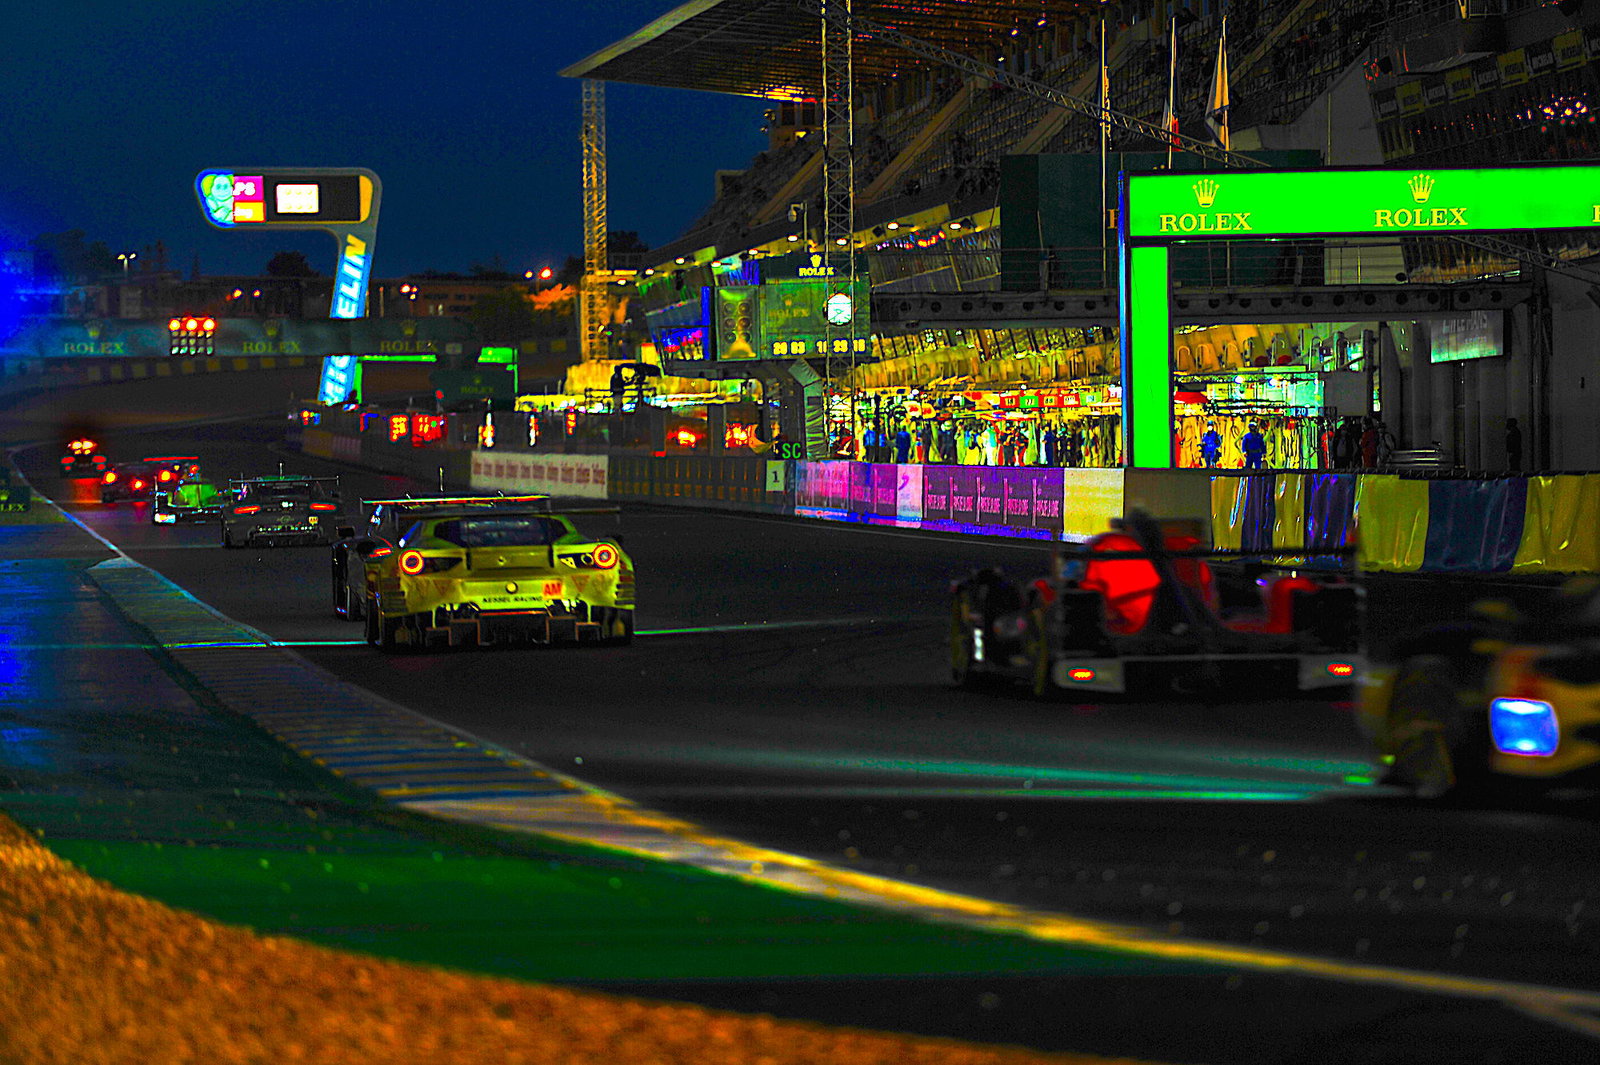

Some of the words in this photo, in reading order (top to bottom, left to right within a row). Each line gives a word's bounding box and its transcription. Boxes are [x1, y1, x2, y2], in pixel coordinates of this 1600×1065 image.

[1159, 212, 1252, 233] ROLEX
[1373, 207, 1468, 228] ROLEX
[798, 266, 835, 277] ROLEX
[324, 234, 366, 406] MICELIN
[63, 341, 124, 354] ROLEX
[242, 341, 301, 353] ROLEX
[380, 341, 438, 352] ROLEX
[782, 443, 801, 459] SC
[772, 470, 780, 483] 1
[544, 583, 562, 596] AM
